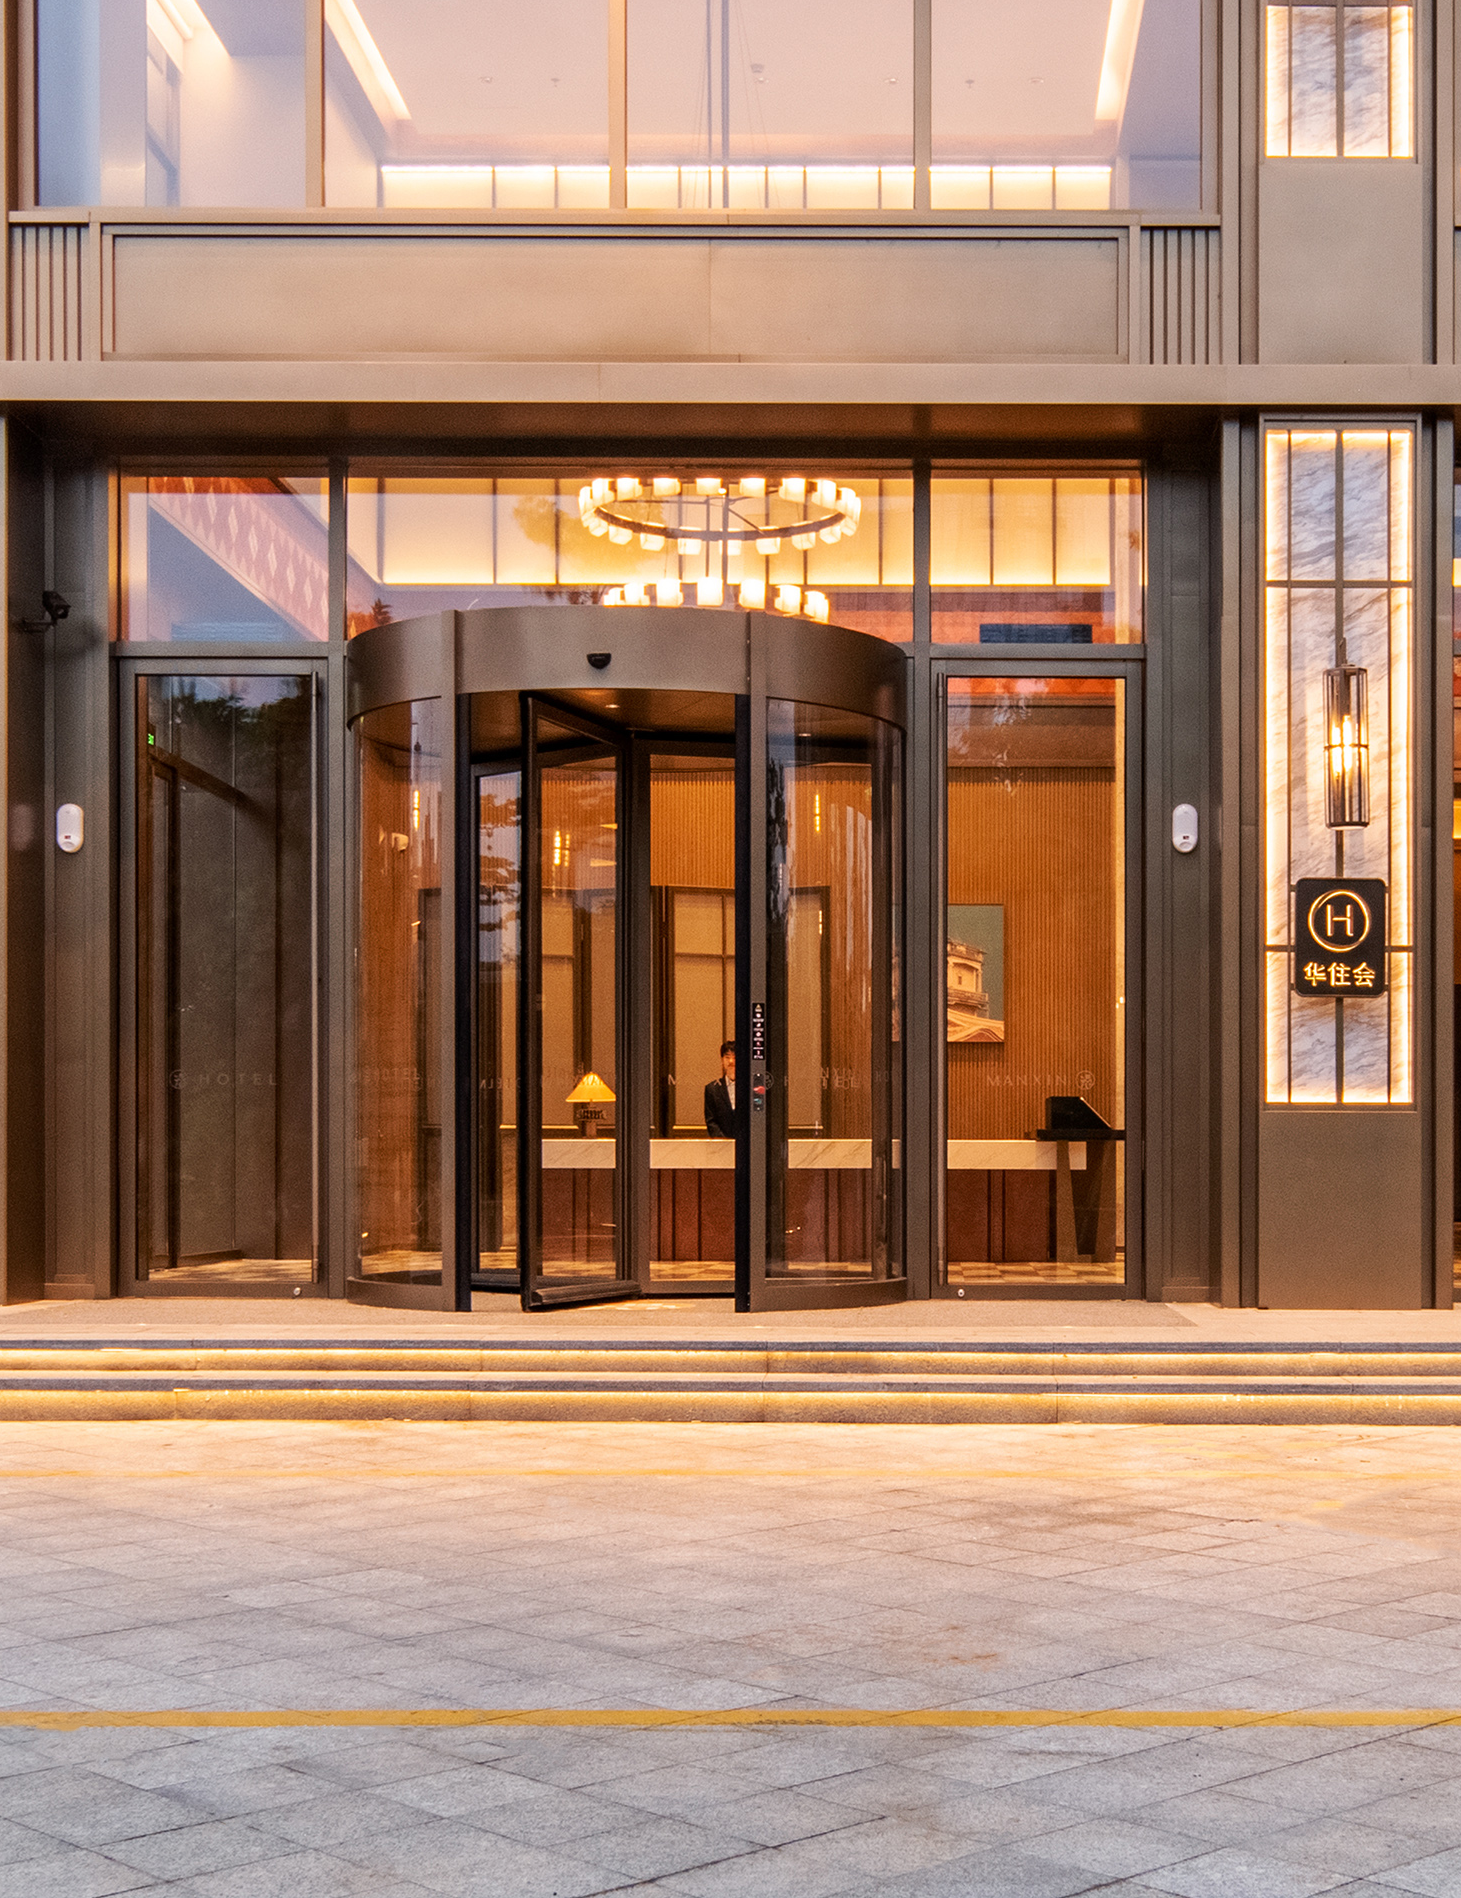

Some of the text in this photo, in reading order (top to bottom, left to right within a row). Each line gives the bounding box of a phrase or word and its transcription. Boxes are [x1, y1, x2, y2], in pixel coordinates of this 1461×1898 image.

[1303, 961, 1375, 987] 华住会
[987, 1074, 1067, 1086] MANXIN
